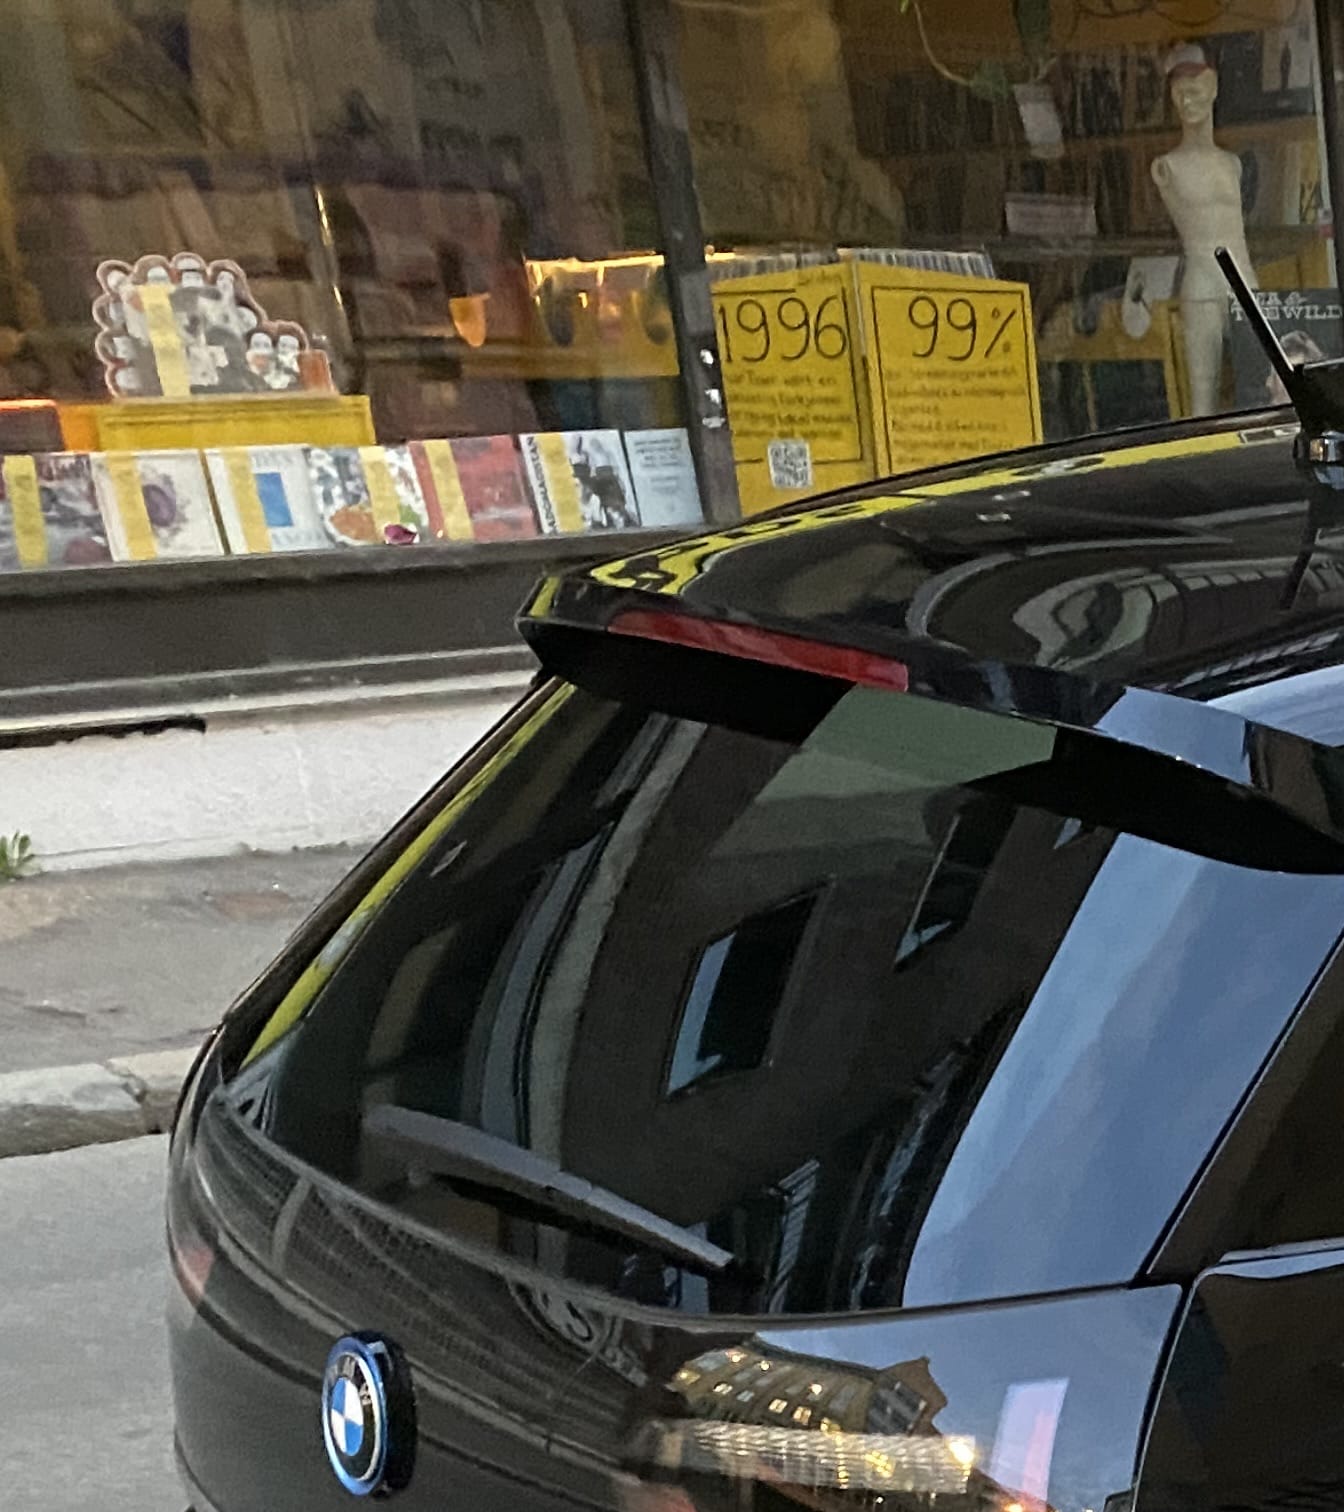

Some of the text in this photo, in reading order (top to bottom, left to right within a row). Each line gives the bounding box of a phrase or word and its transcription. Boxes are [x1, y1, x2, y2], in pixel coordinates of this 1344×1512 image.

[719, 295, 847, 363] 1996
[908, 295, 1017, 362] 99%
[1281, 305, 1343, 320] WILD
